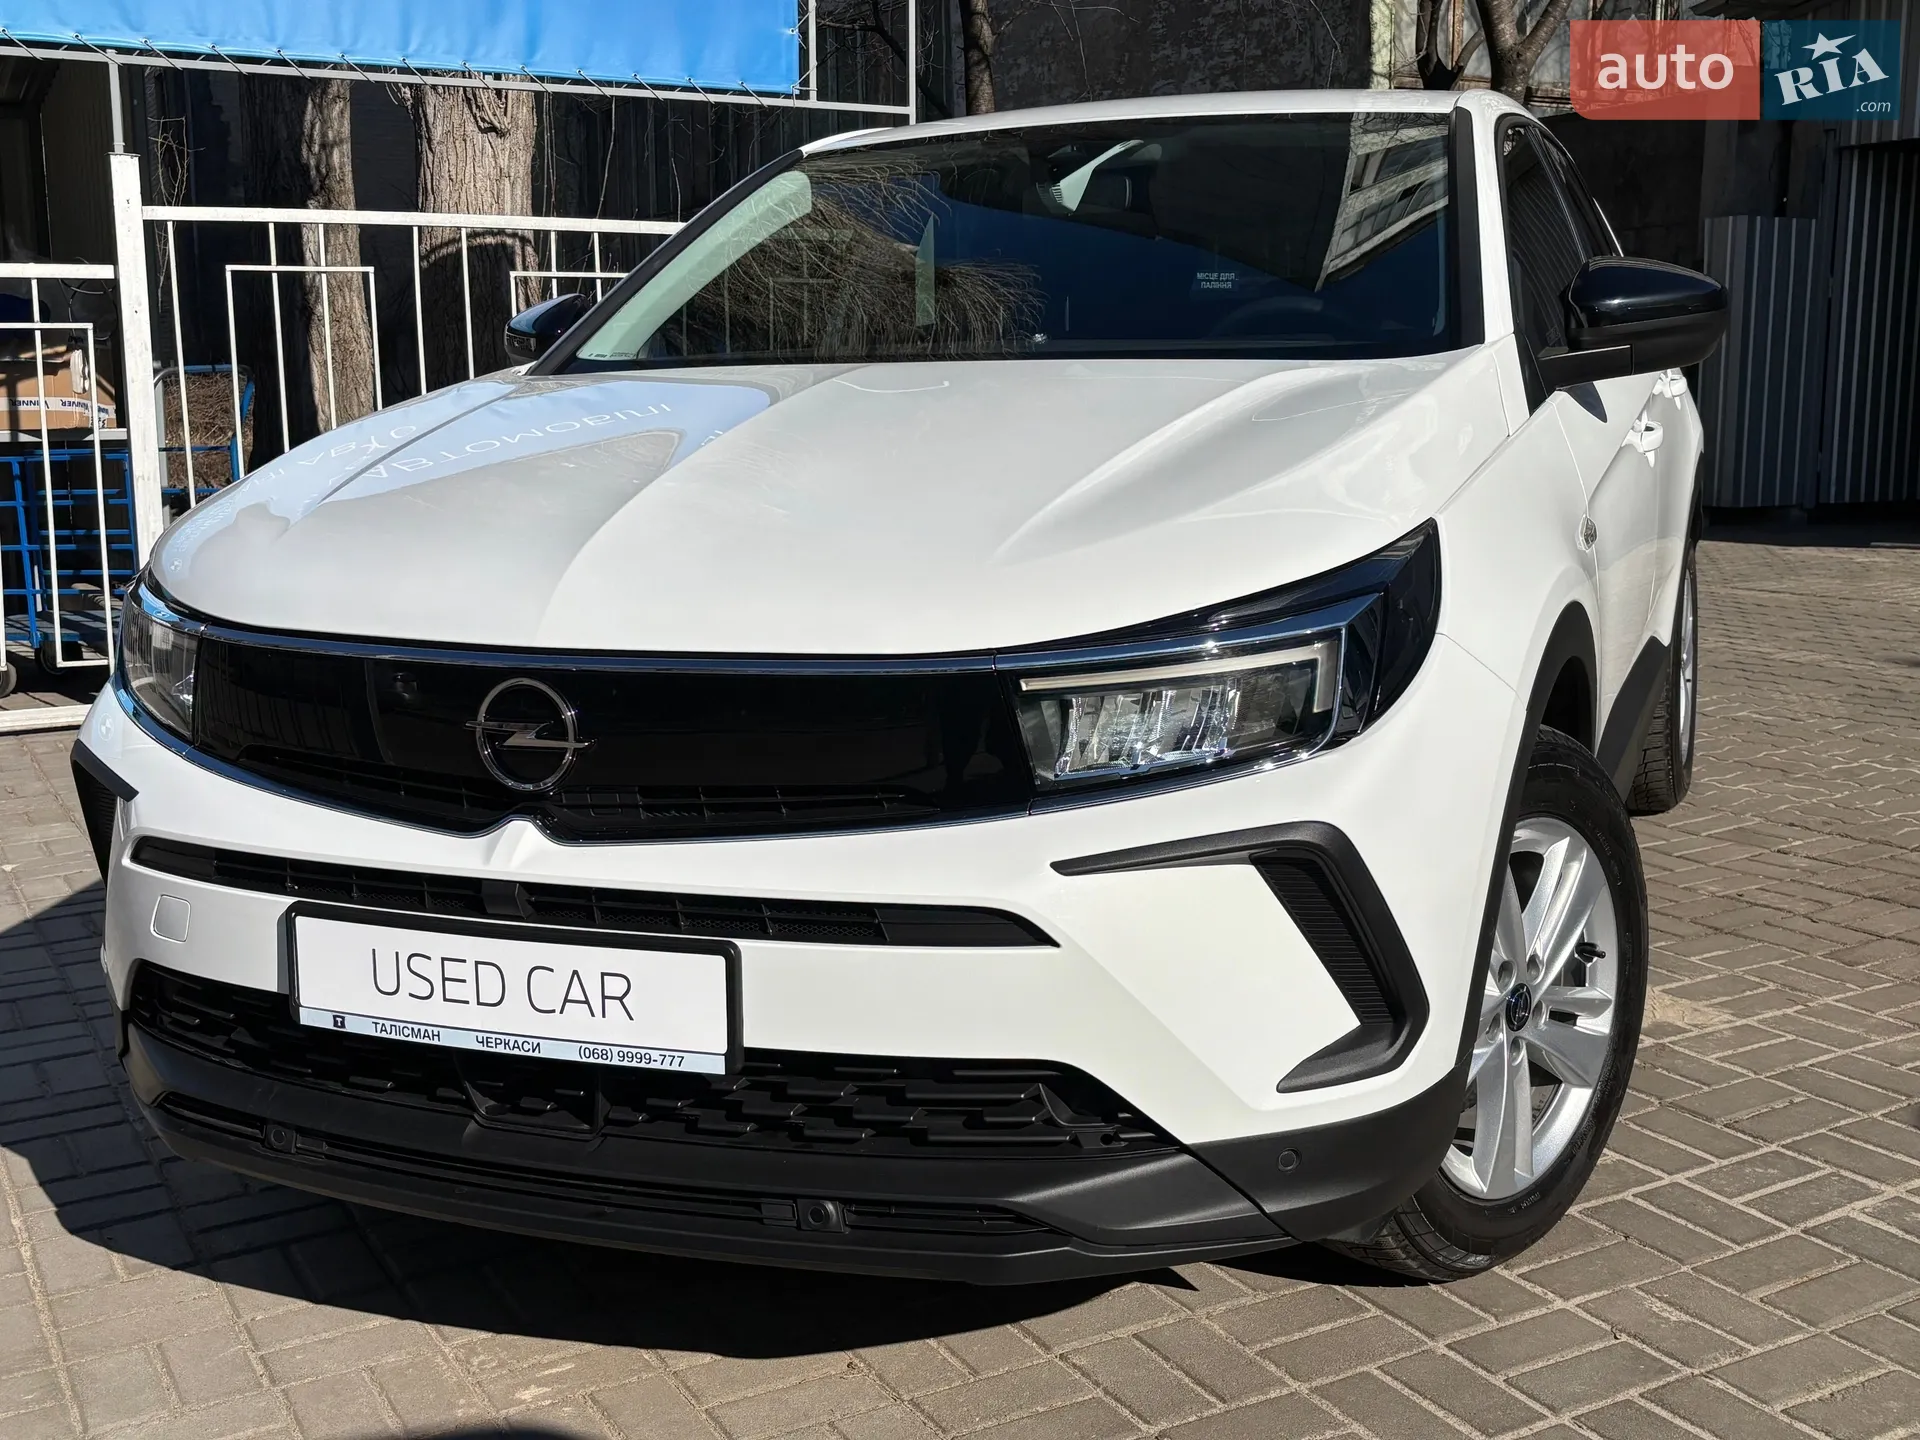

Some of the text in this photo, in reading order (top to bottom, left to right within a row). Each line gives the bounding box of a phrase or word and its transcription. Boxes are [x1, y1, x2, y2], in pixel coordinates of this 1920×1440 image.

[1197, 272, 1235, 281] МІСЦЕ ДЛЯ
[1200, 281, 1232, 289] ПАЛІННЯ
[371, 948, 635, 1022] USED CAR
[371, 1021, 441, 1043] ТАЛІСМАН
[475, 1035, 541, 1055] ЧЕРКАСИ
[578, 1045, 613, 1062] (068)
[617, 1052, 685, 1068] 9999-777
